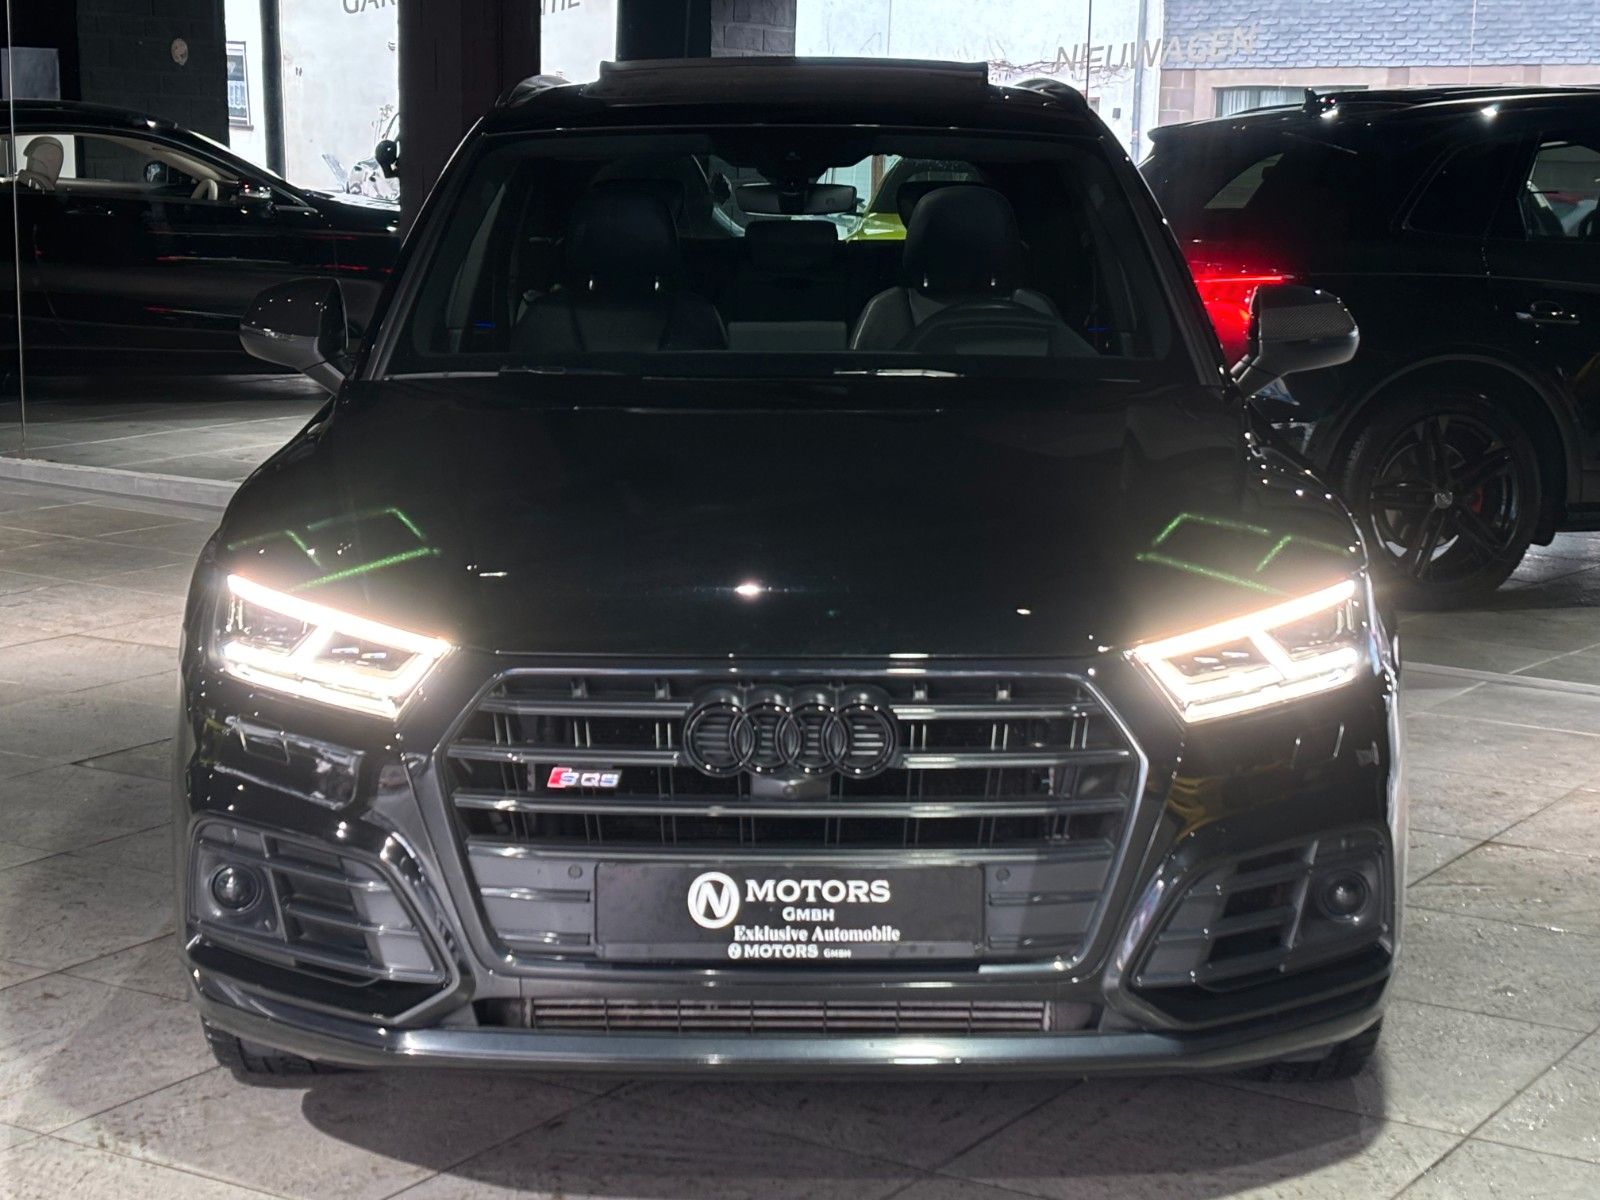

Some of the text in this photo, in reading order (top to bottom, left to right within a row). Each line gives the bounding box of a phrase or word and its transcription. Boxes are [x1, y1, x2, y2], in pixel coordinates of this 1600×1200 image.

[745, 878, 892, 903] MOTORS
[733, 925, 901, 942] Exklusive Automobile
[744, 943, 818, 958] MOTORS
